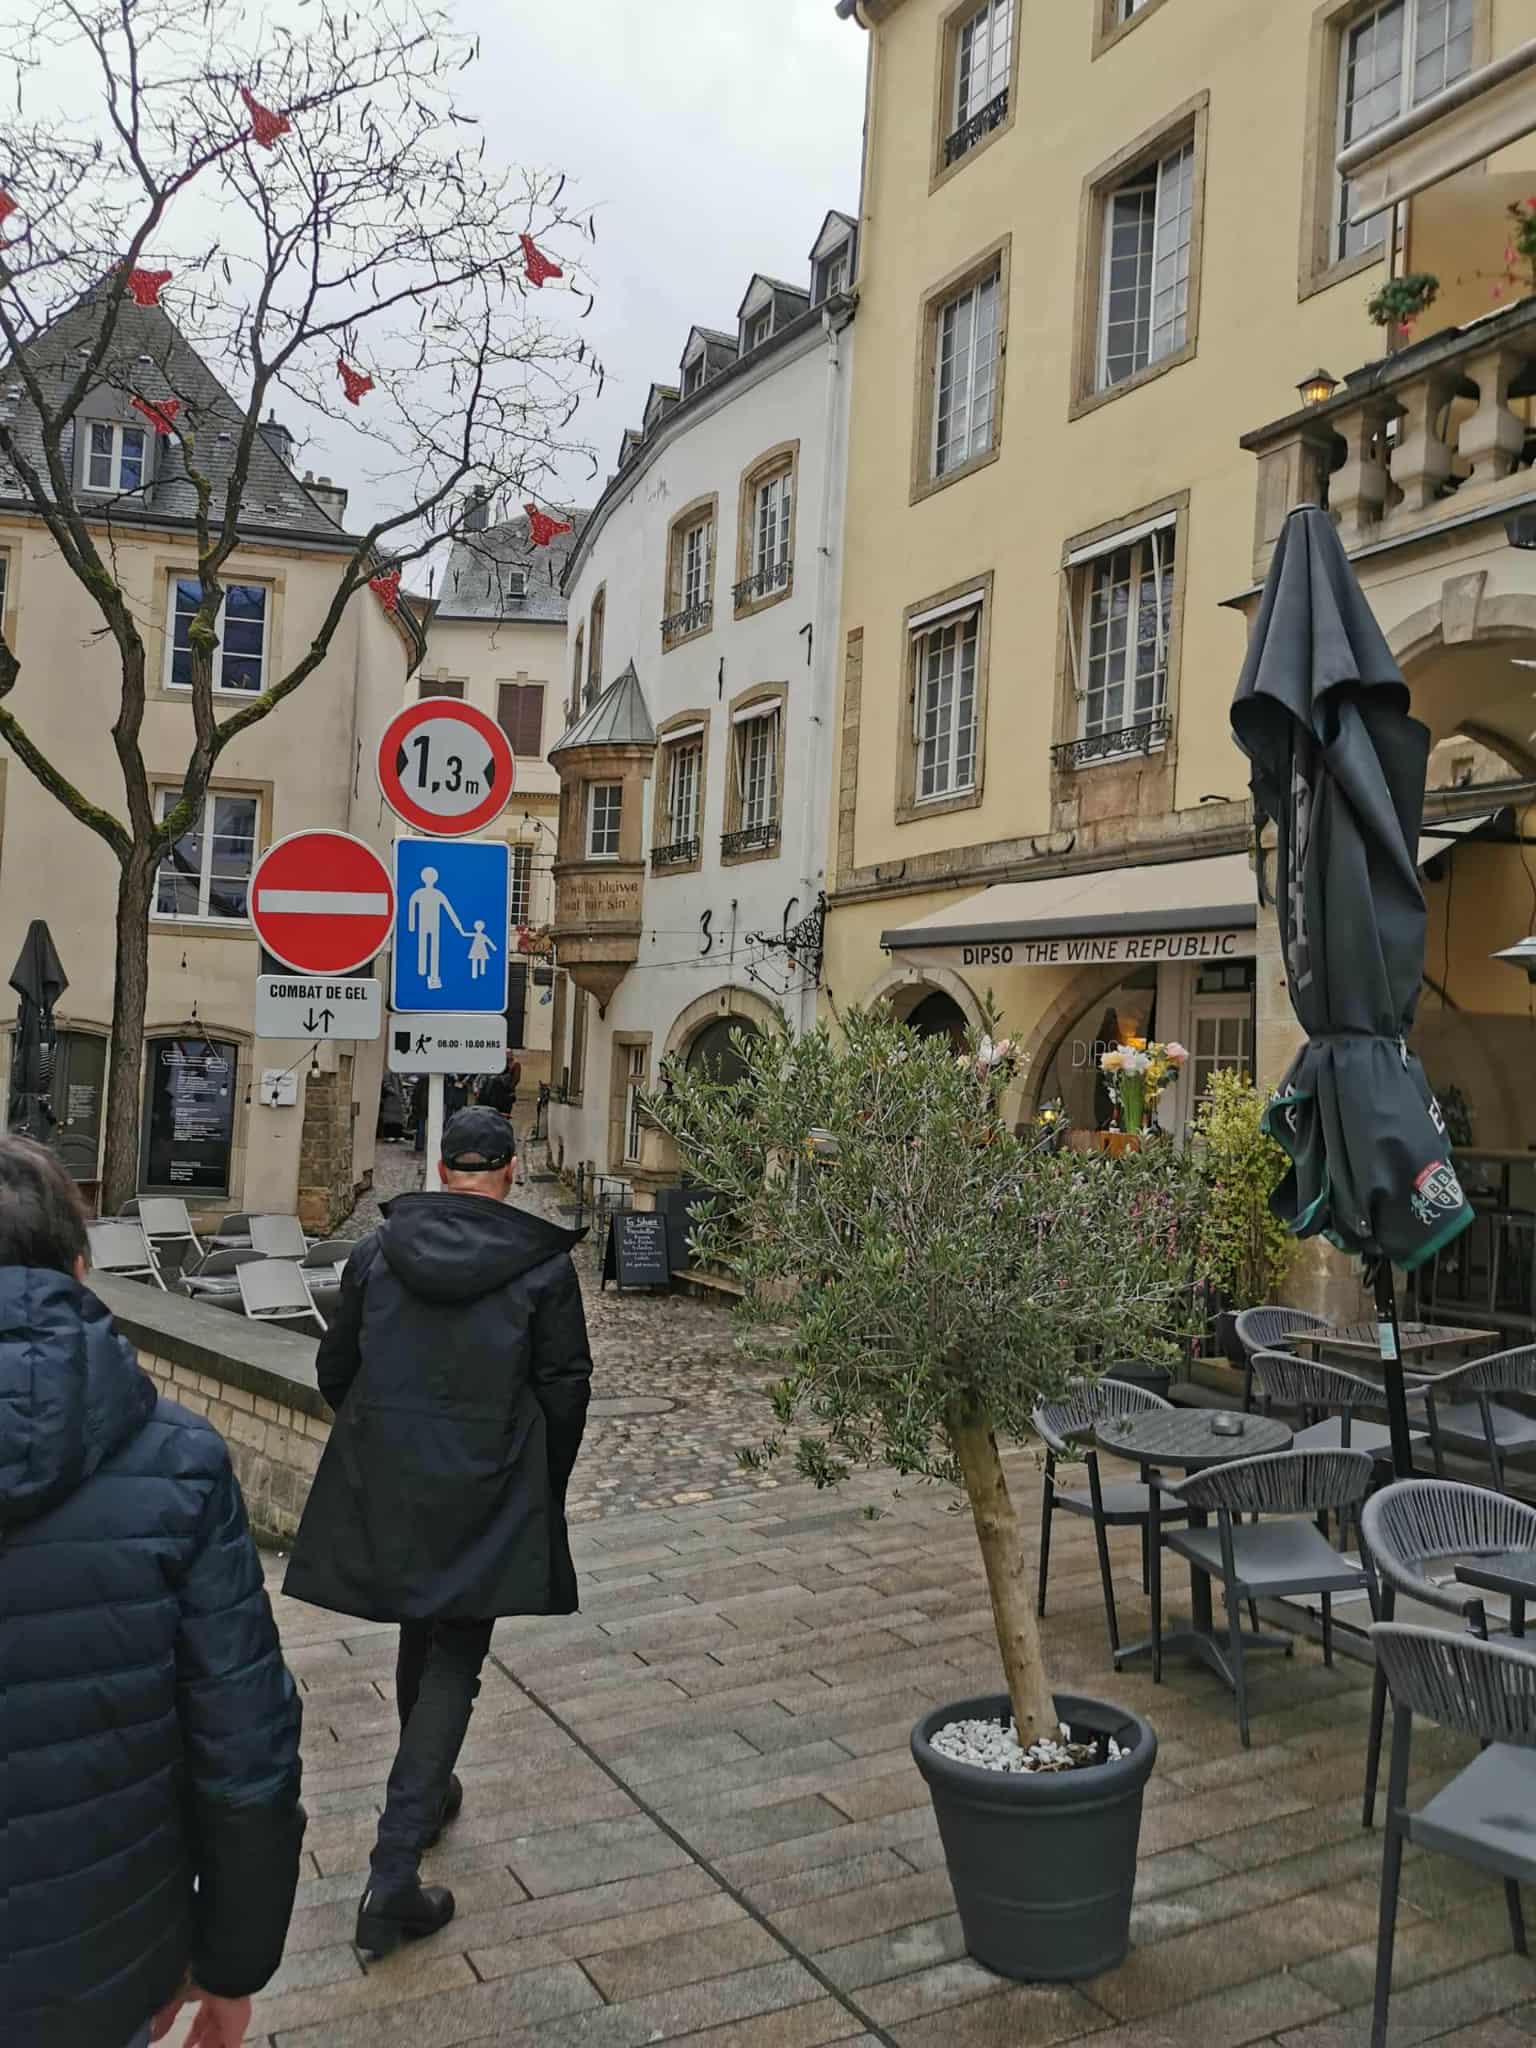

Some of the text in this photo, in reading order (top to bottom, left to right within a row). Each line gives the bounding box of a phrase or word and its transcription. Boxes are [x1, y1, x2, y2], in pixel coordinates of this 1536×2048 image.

[963, 934, 1237, 965] DIPSO THE WINE REPUBLIC
[269, 984, 368, 1000] COMBAT DE GEL
[486, 1039, 501, 1049] HRS
